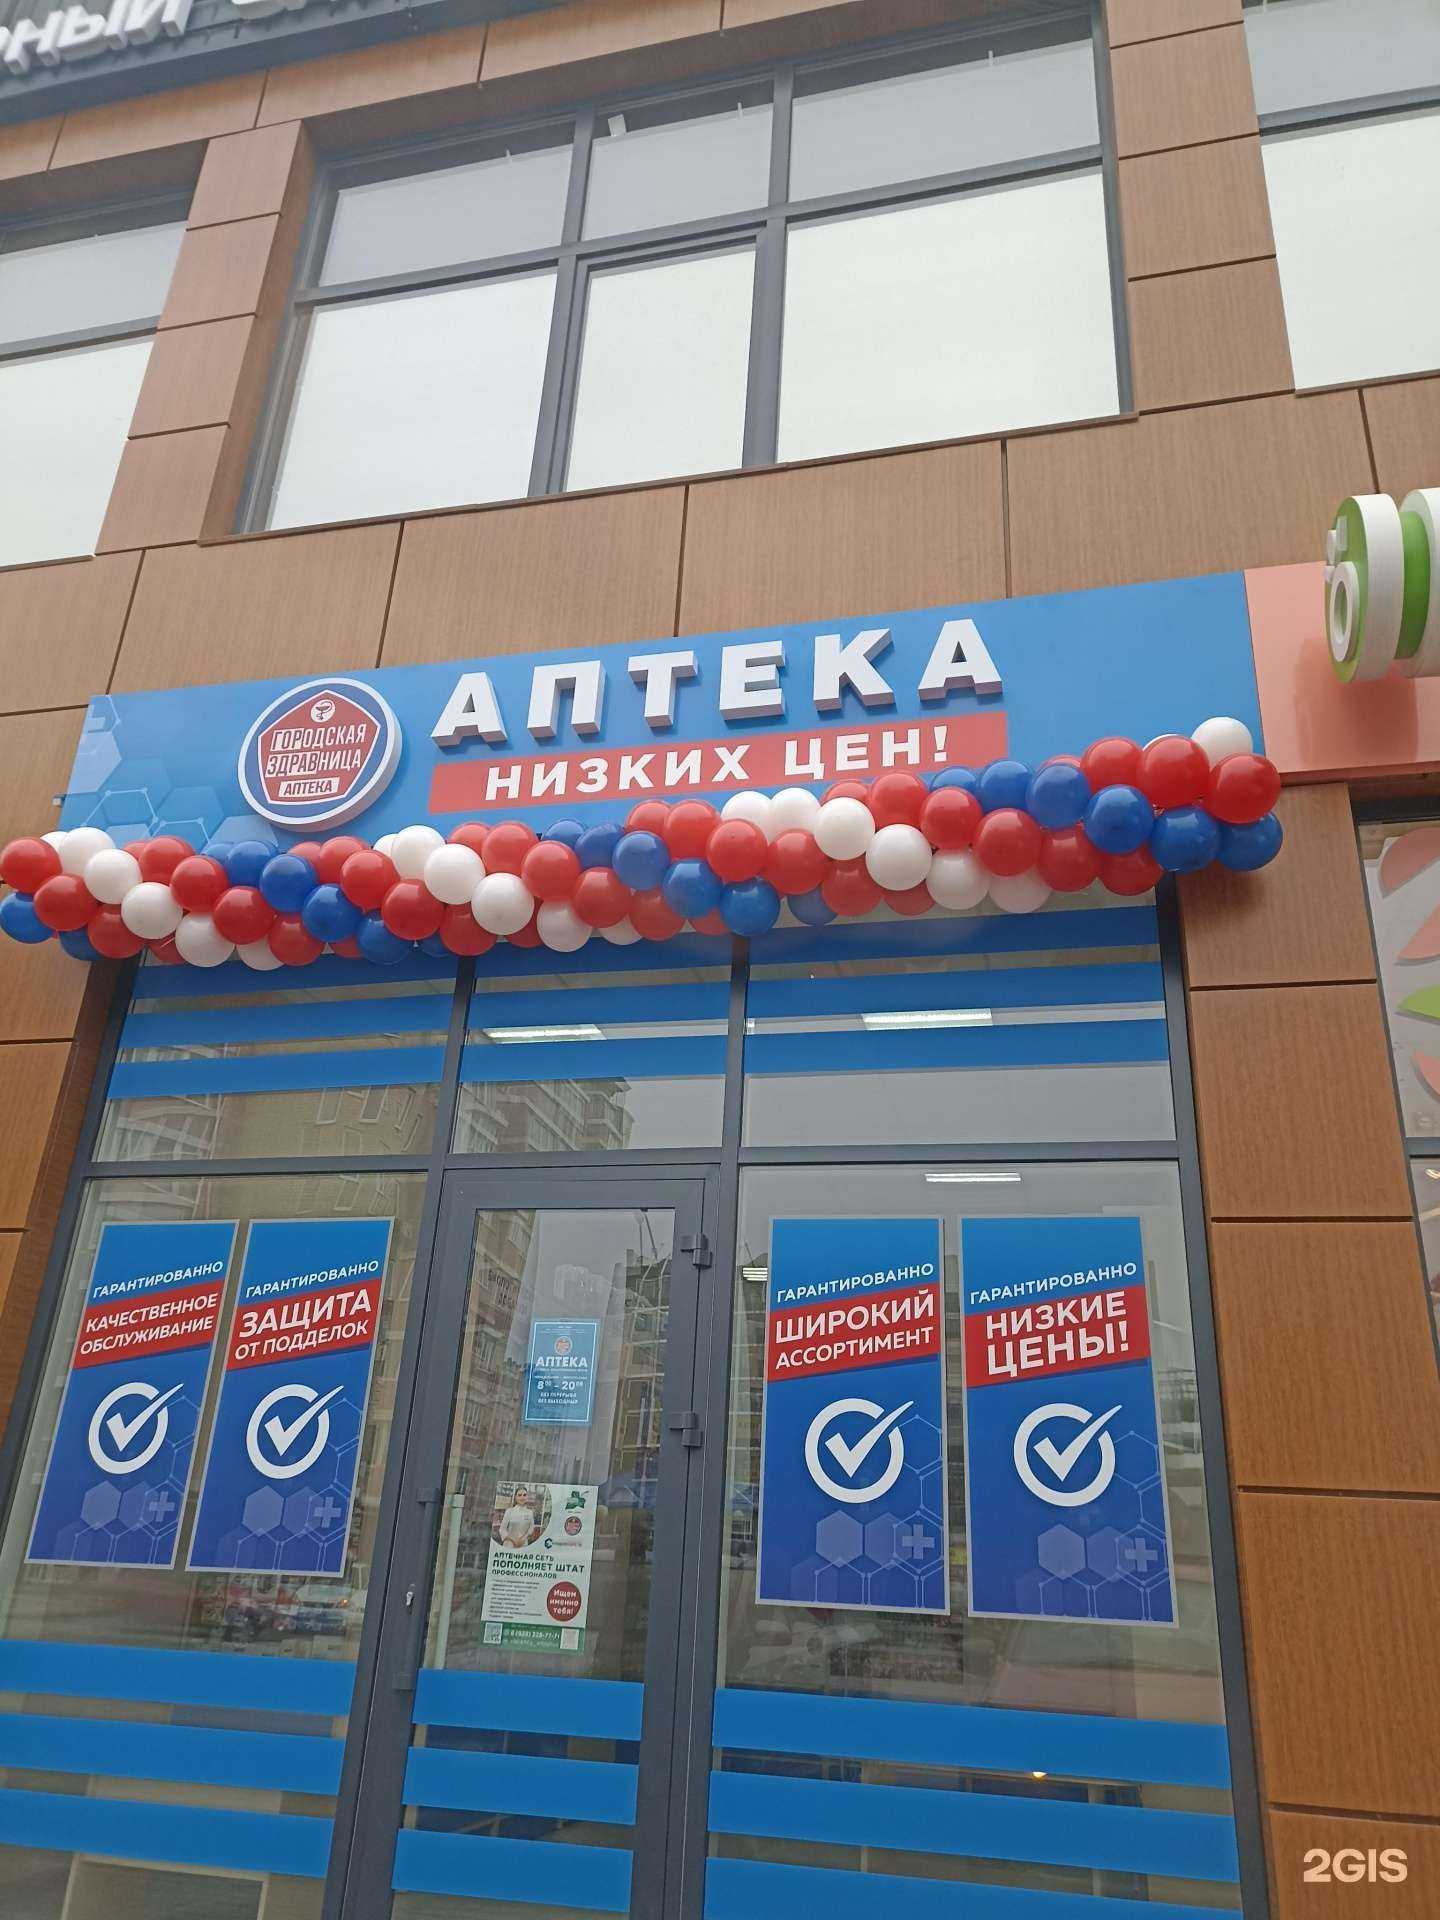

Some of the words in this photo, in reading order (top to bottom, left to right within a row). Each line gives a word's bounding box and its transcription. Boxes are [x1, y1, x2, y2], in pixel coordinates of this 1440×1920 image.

[431, 618, 1003, 747] АПТЕКА
[271, 724, 367, 751] ГОРОДСКАЯ
[265, 749, 362, 777] ЗДРАВНИЦА
[485, 743, 751, 801] НИЗКИХ
[784, 725, 949, 780] ЦЕН!
[283, 779, 333, 796] АПТЕКА
[93, 1260, 224, 1298] ГАРАНТИРОВАННО
[246, 1260, 379, 1298] ГАРАНТИРОВАННО
[777, 1263, 934, 1303] ГАРАНТИРОВАННО
[969, 1262, 1137, 1305] ГАРАНТИРОВАННО
[86, 1293, 219, 1333] КАЧЕСТВЕННОЕ
[239, 1288, 372, 1338] ЗАЩИТА
[775, 1289, 935, 1344] ШИРОКИЙ
[986, 1290, 1127, 1340] НИЗКИЕ
[80, 1317, 213, 1355] ОБСЛУЖИВАНИЕ
[235, 1344, 258, 1360] ОТ
[262, 1320, 369, 1355] ПОДДЕЛОК
[775, 1326, 934, 1370] АССОРТИМЕНТ
[987, 1320, 1130, 1377] ЦЕНЫ!
[535, 1356, 588, 1368] АПТЕКА
[491, 1569, 558, 1579] ПРОФЕССИОНАЛОВ
[492, 1560, 553, 1571] ПОПОЛНЯЕТ
[555, 1564, 585, 1573] ШТАТ
[494, 1552, 534, 1561] АПТЕЧНАЯ
[535, 1554, 554, 1562] СЕТЬ
[549, 1599, 579, 1607] именно
[553, 1589, 577, 1598] Ищем
